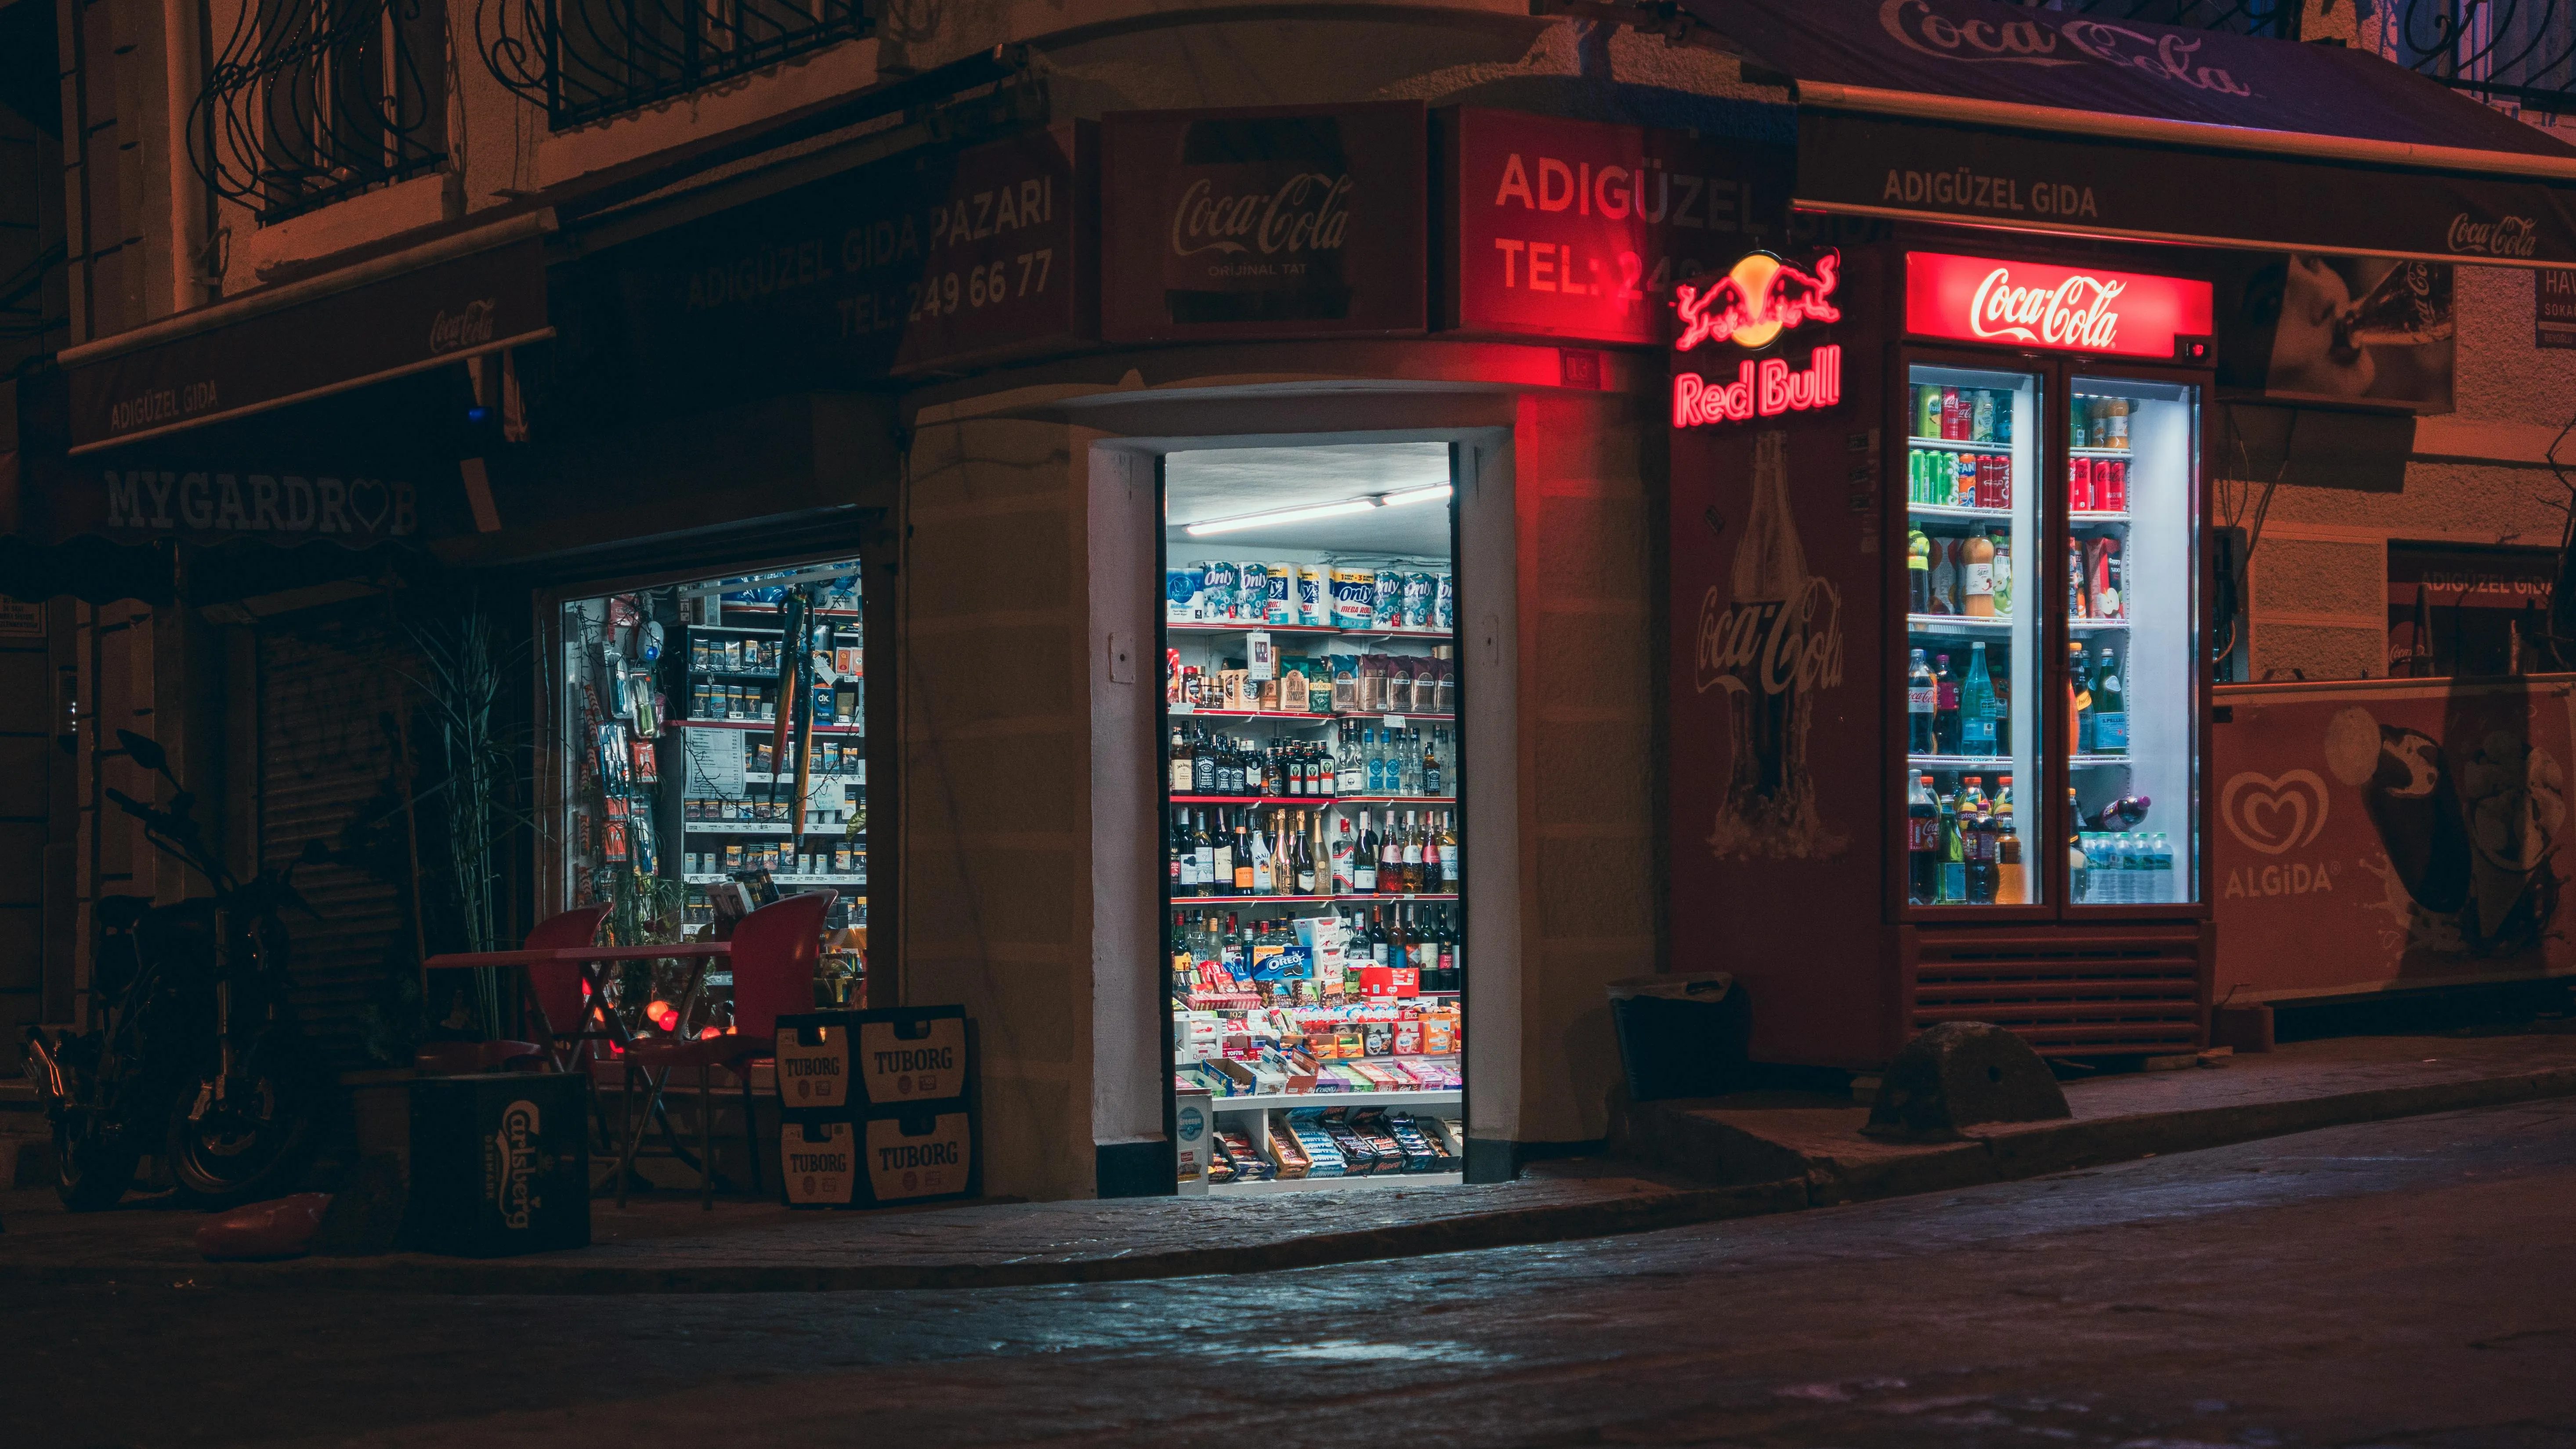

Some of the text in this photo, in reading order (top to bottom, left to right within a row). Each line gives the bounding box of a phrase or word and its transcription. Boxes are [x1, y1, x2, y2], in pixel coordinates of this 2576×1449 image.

[1172, 173, 1352, 256] Coca-Cola
[1495, 153, 1768, 233] ADIGÜZEL
[1884, 166, 2098, 217] ADIGÜZEL GIDA
[686, 175, 1051, 312] ADIGÜZEL GIDA PAZARI
[2448, 213, 2538, 257] Coca-Cola
[1283, 263, 1307, 274] TAT
[1495, 238, 1599, 296] TEL:
[837, 248, 1052, 337] TEL: 249 66 77
[1971, 268, 2127, 349] Coca-Cola
[2544, 303, 2576, 317] SOKA
[430, 298, 496, 352] Coca-Cola
[110, 379, 218, 431] ADIGÜZEL GIDA
[1675, 345, 1840, 427] Red Bull
[1205, 570, 1235, 586] Only
[1242, 573, 1268, 588] Only
[1340, 586, 1373, 603] Only
[1404, 582, 1432, 594] Only
[2421, 569, 2510, 594] ADIGÜZEL
[1696, 576, 1844, 695] Coca-Cola
[1269, 956, 1299, 969] OREO
[785, 1057, 840, 1077] TUBORG
[874, 1047, 953, 1074] TUBORG
[484, 1135, 494, 1199] DENMARK
[496, 1100, 542, 1229] Carlsberg
[790, 1153, 847, 1173] TUBORG
[879, 1141, 958, 1171] TUBORG
